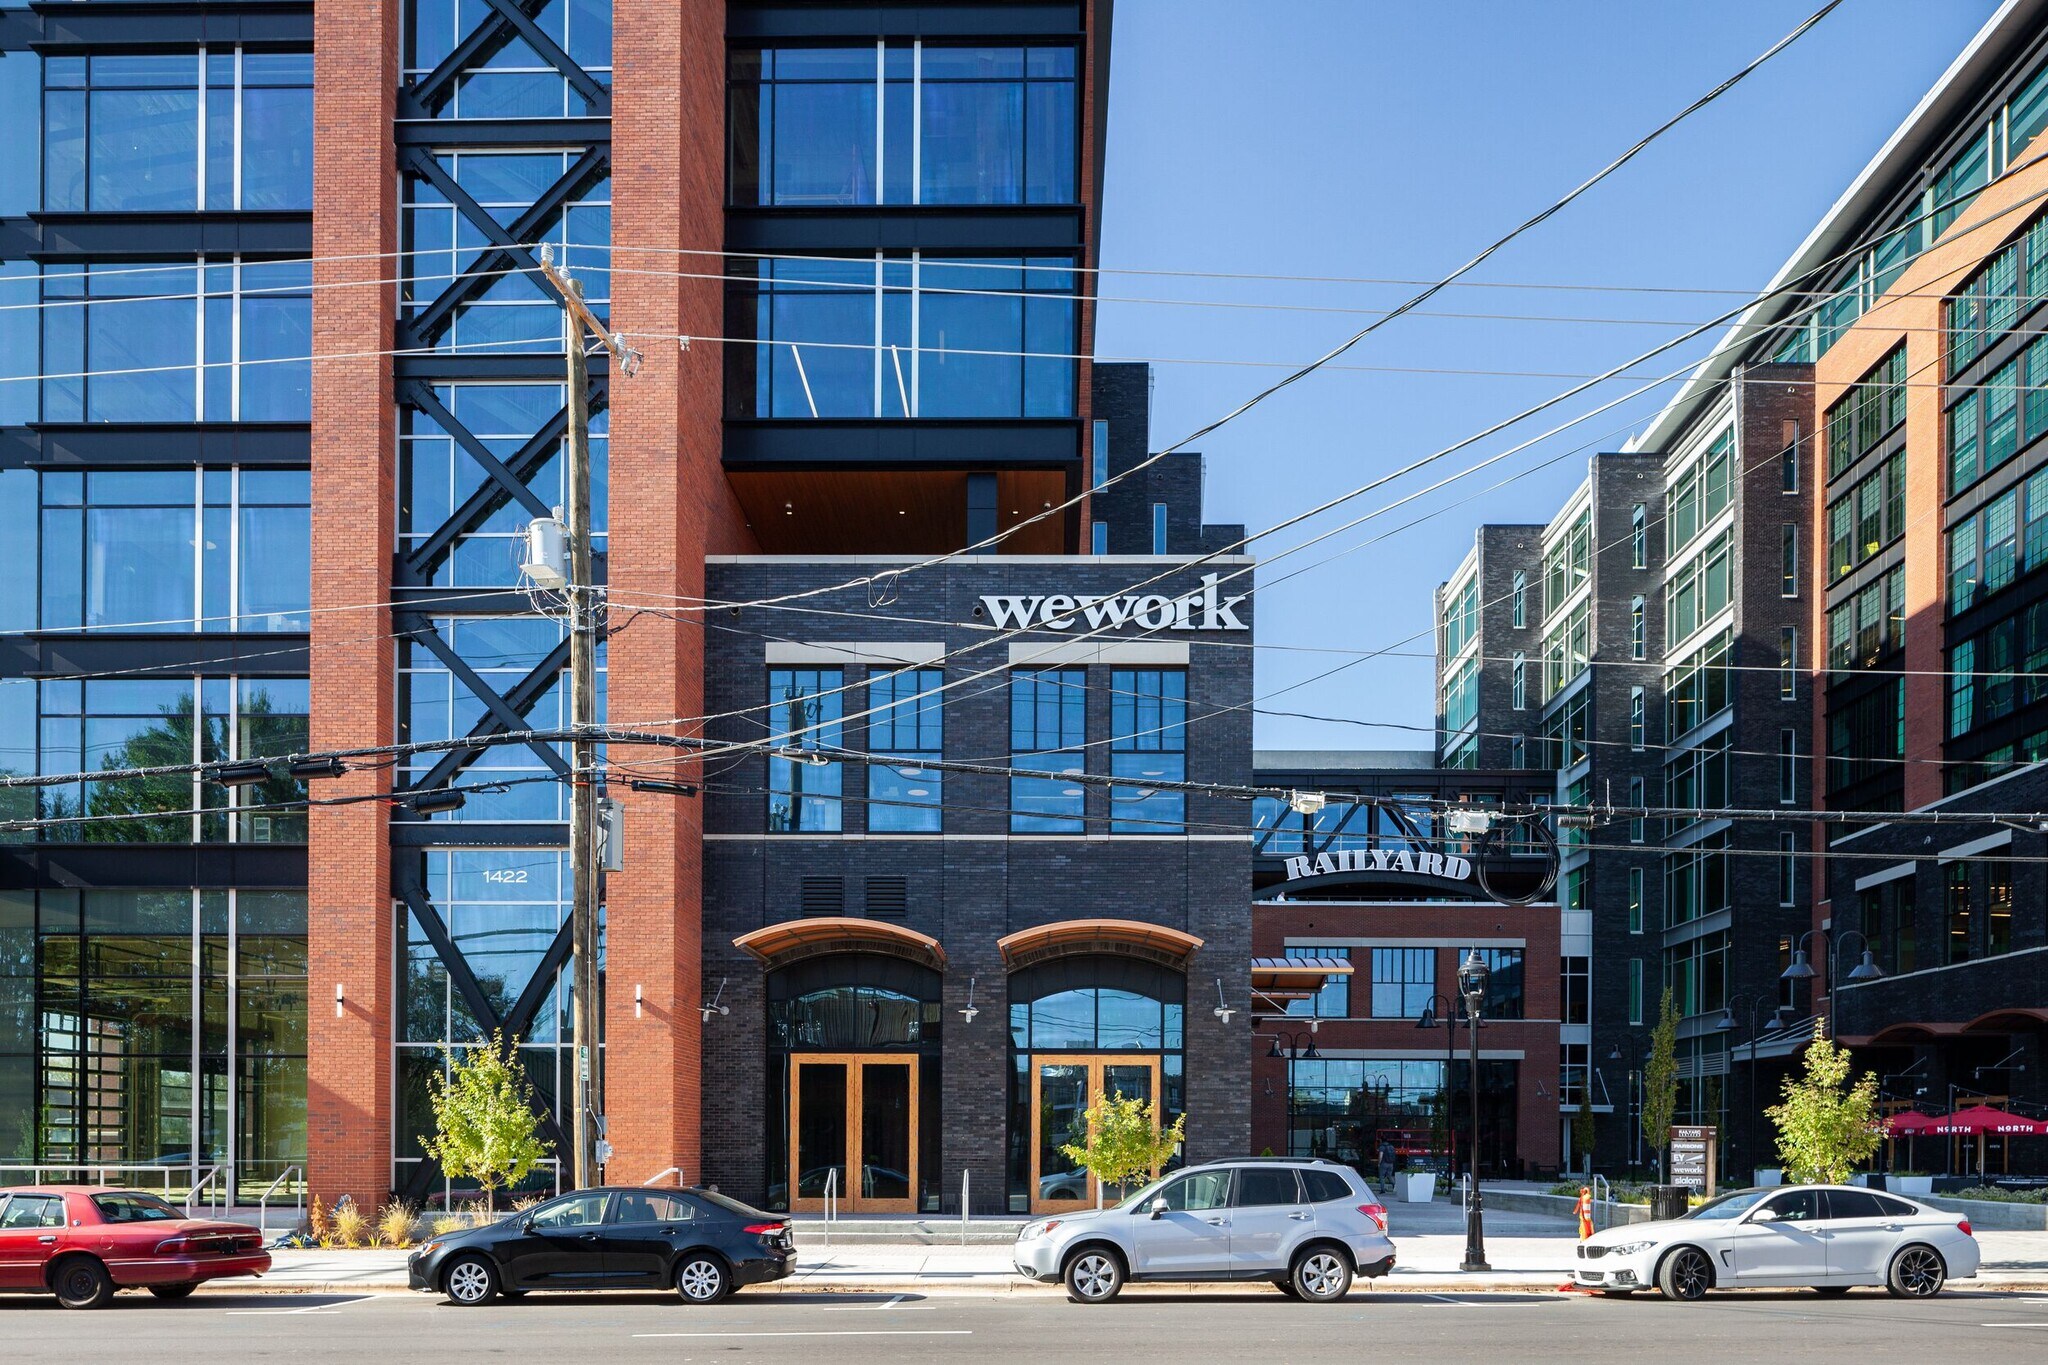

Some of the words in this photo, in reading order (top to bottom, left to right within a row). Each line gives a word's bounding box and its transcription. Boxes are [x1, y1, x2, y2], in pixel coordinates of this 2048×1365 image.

[979, 572, 1250, 631] wework
[1283, 849, 1472, 881] RAILYARD
[482, 870, 528, 883] 1422
[1997, 1125, 2034, 1133] NORTH
[1673, 1154, 1685, 1162] EY
[1673, 1166, 1703, 1174] wework
[1674, 1176, 1702, 1185] slalom
